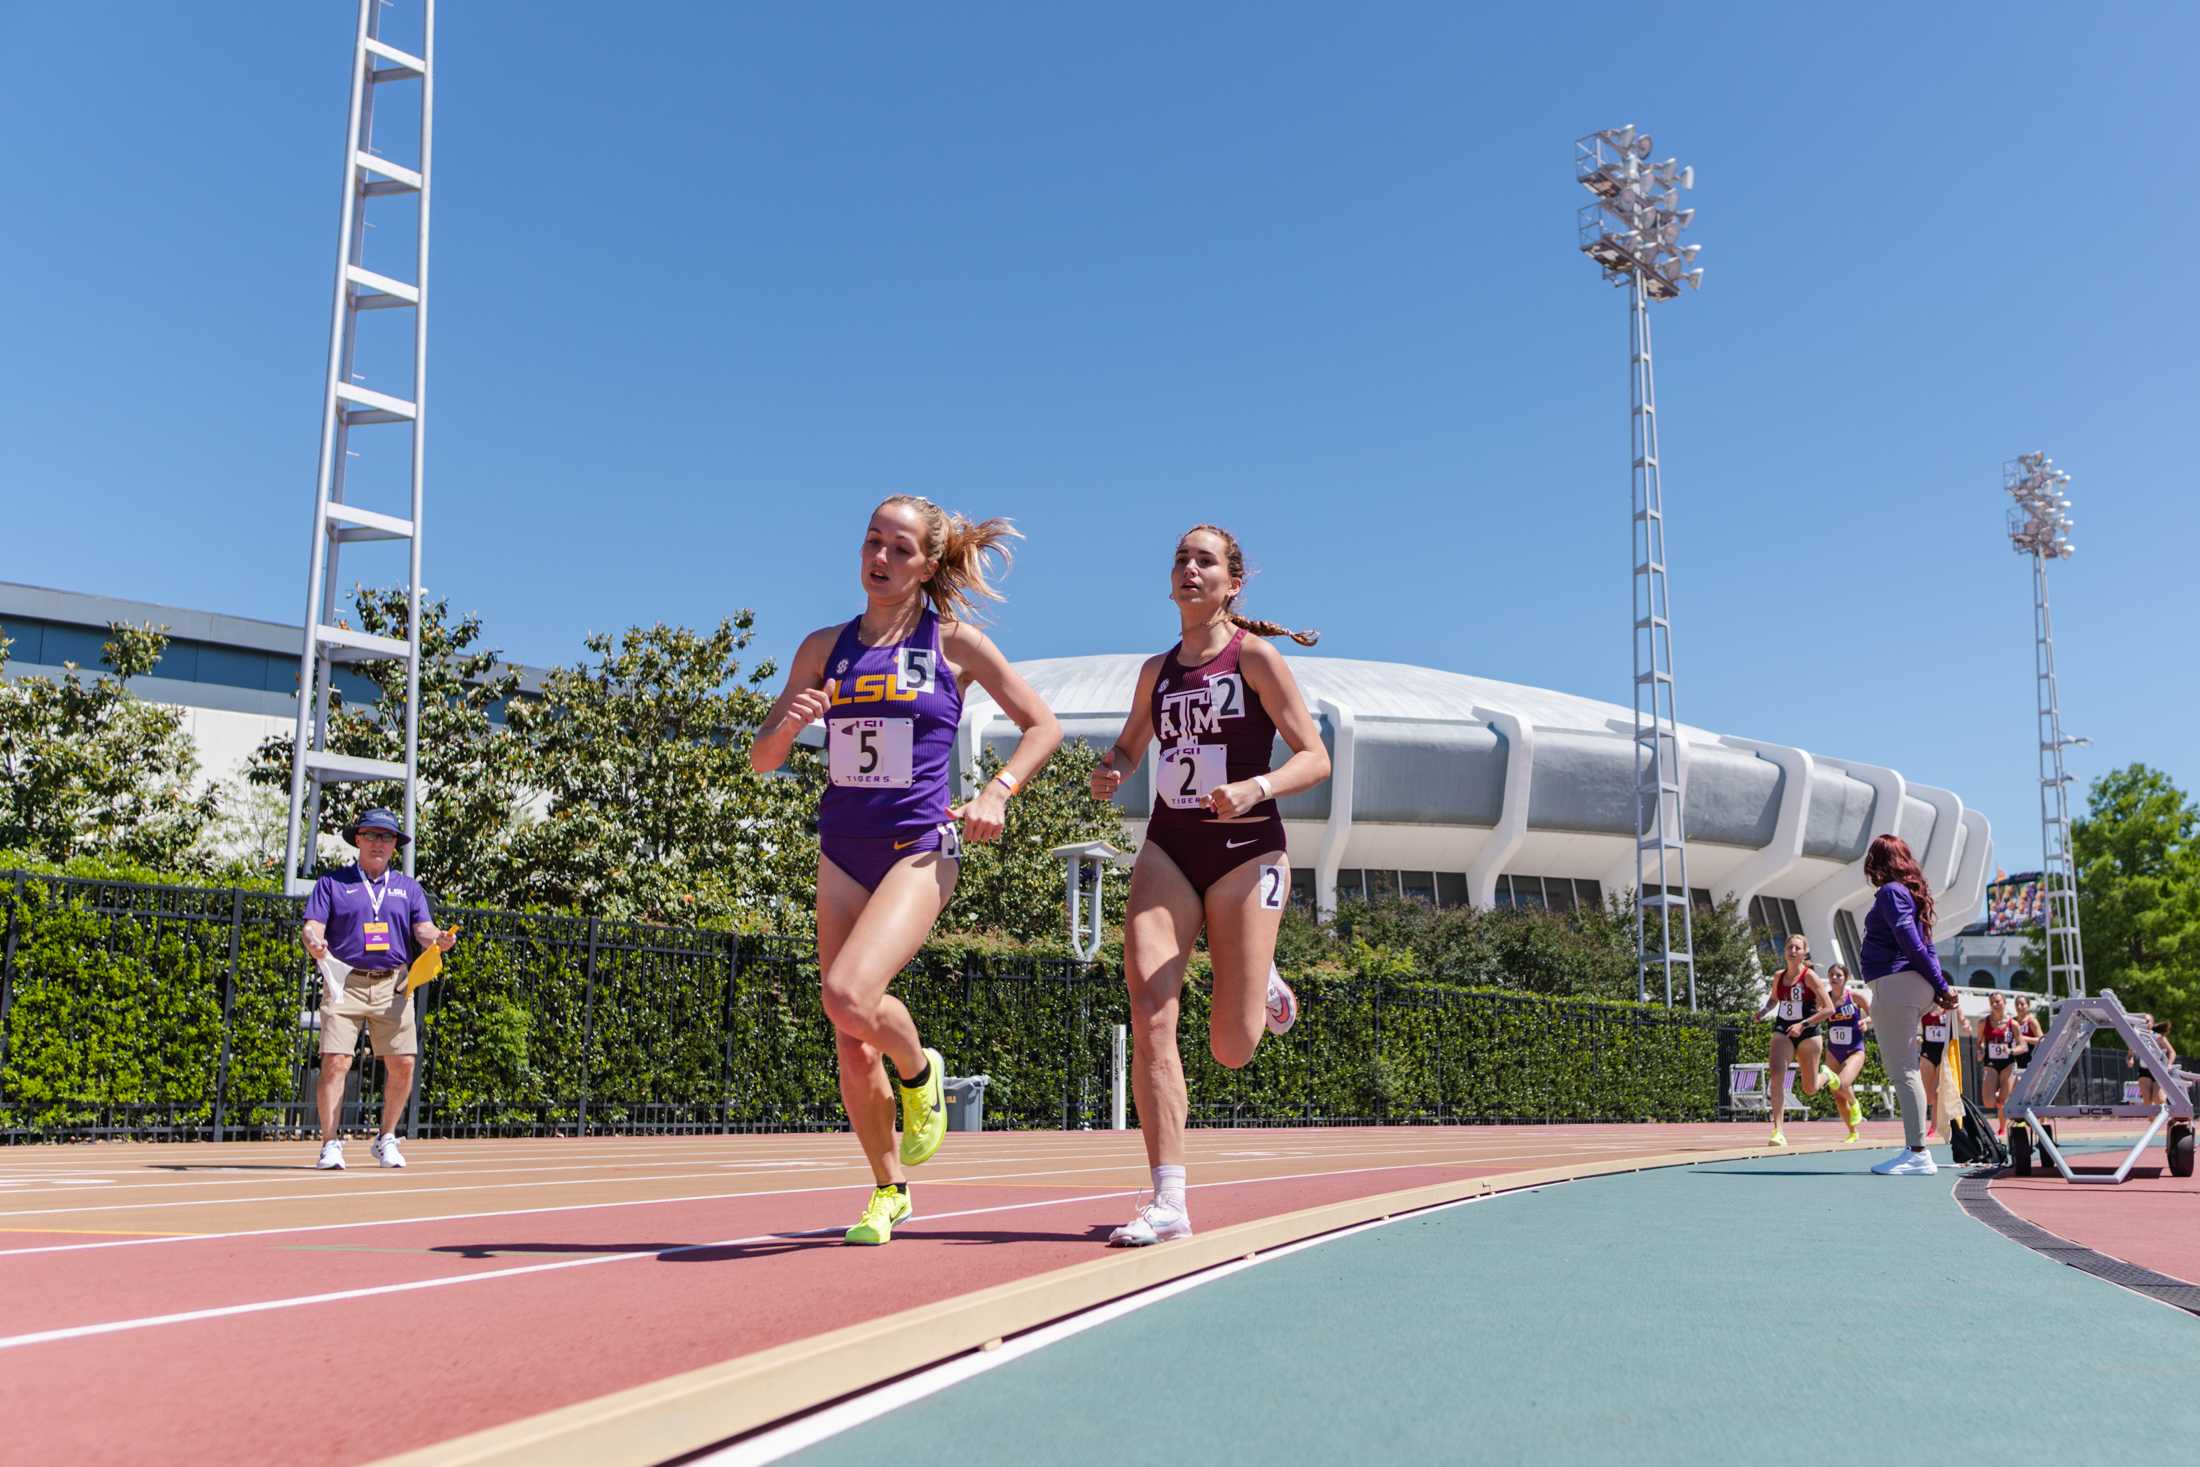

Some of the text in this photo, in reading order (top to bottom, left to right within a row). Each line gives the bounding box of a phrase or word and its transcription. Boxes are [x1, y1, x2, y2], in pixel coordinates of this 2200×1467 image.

[907, 651, 927, 688] 5
[1217, 678, 1239, 716] 2
[859, 730, 878, 773] 5
[846, 775, 890, 783] TIGERS
[1180, 757, 1196, 796] 2
[1266, 867, 1280, 906] 2
[1793, 987, 1800, 1000] 8
[1787, 1003, 1793, 1016] 8
[1836, 1031, 1846, 1041] 10
[1995, 1045, 2002, 1056] 9
[2080, 1107, 2112, 1115] UCS
